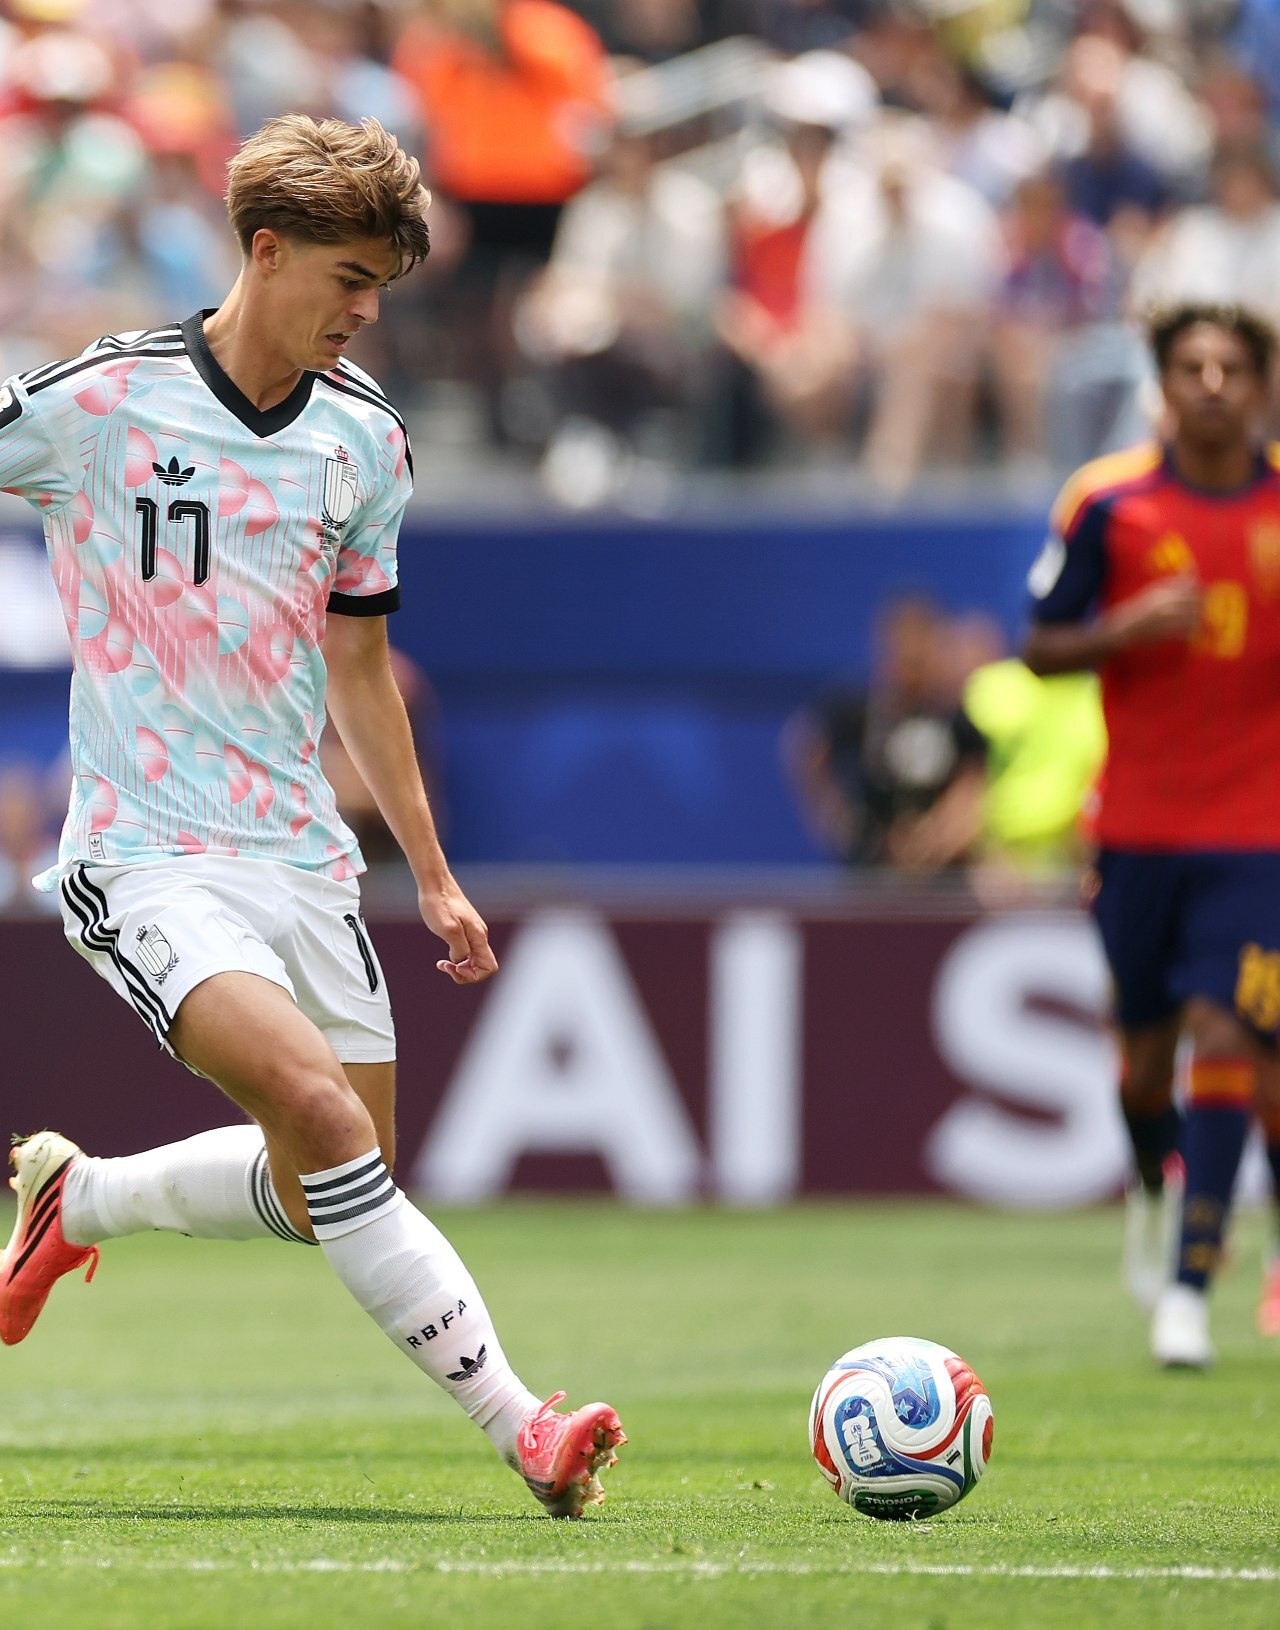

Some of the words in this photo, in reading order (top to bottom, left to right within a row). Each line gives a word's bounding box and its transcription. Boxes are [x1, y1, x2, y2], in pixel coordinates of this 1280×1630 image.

[136, 496, 210, 588] 17
[1190, 578, 1248, 660] 9
[343, 913, 378, 995] 1
[406, 905, 806, 1208] AI
[925, 908, 1145, 1208] S
[406, 1299, 467, 1350] RBFA
[865, 1494, 923, 1506] TRIONDA
